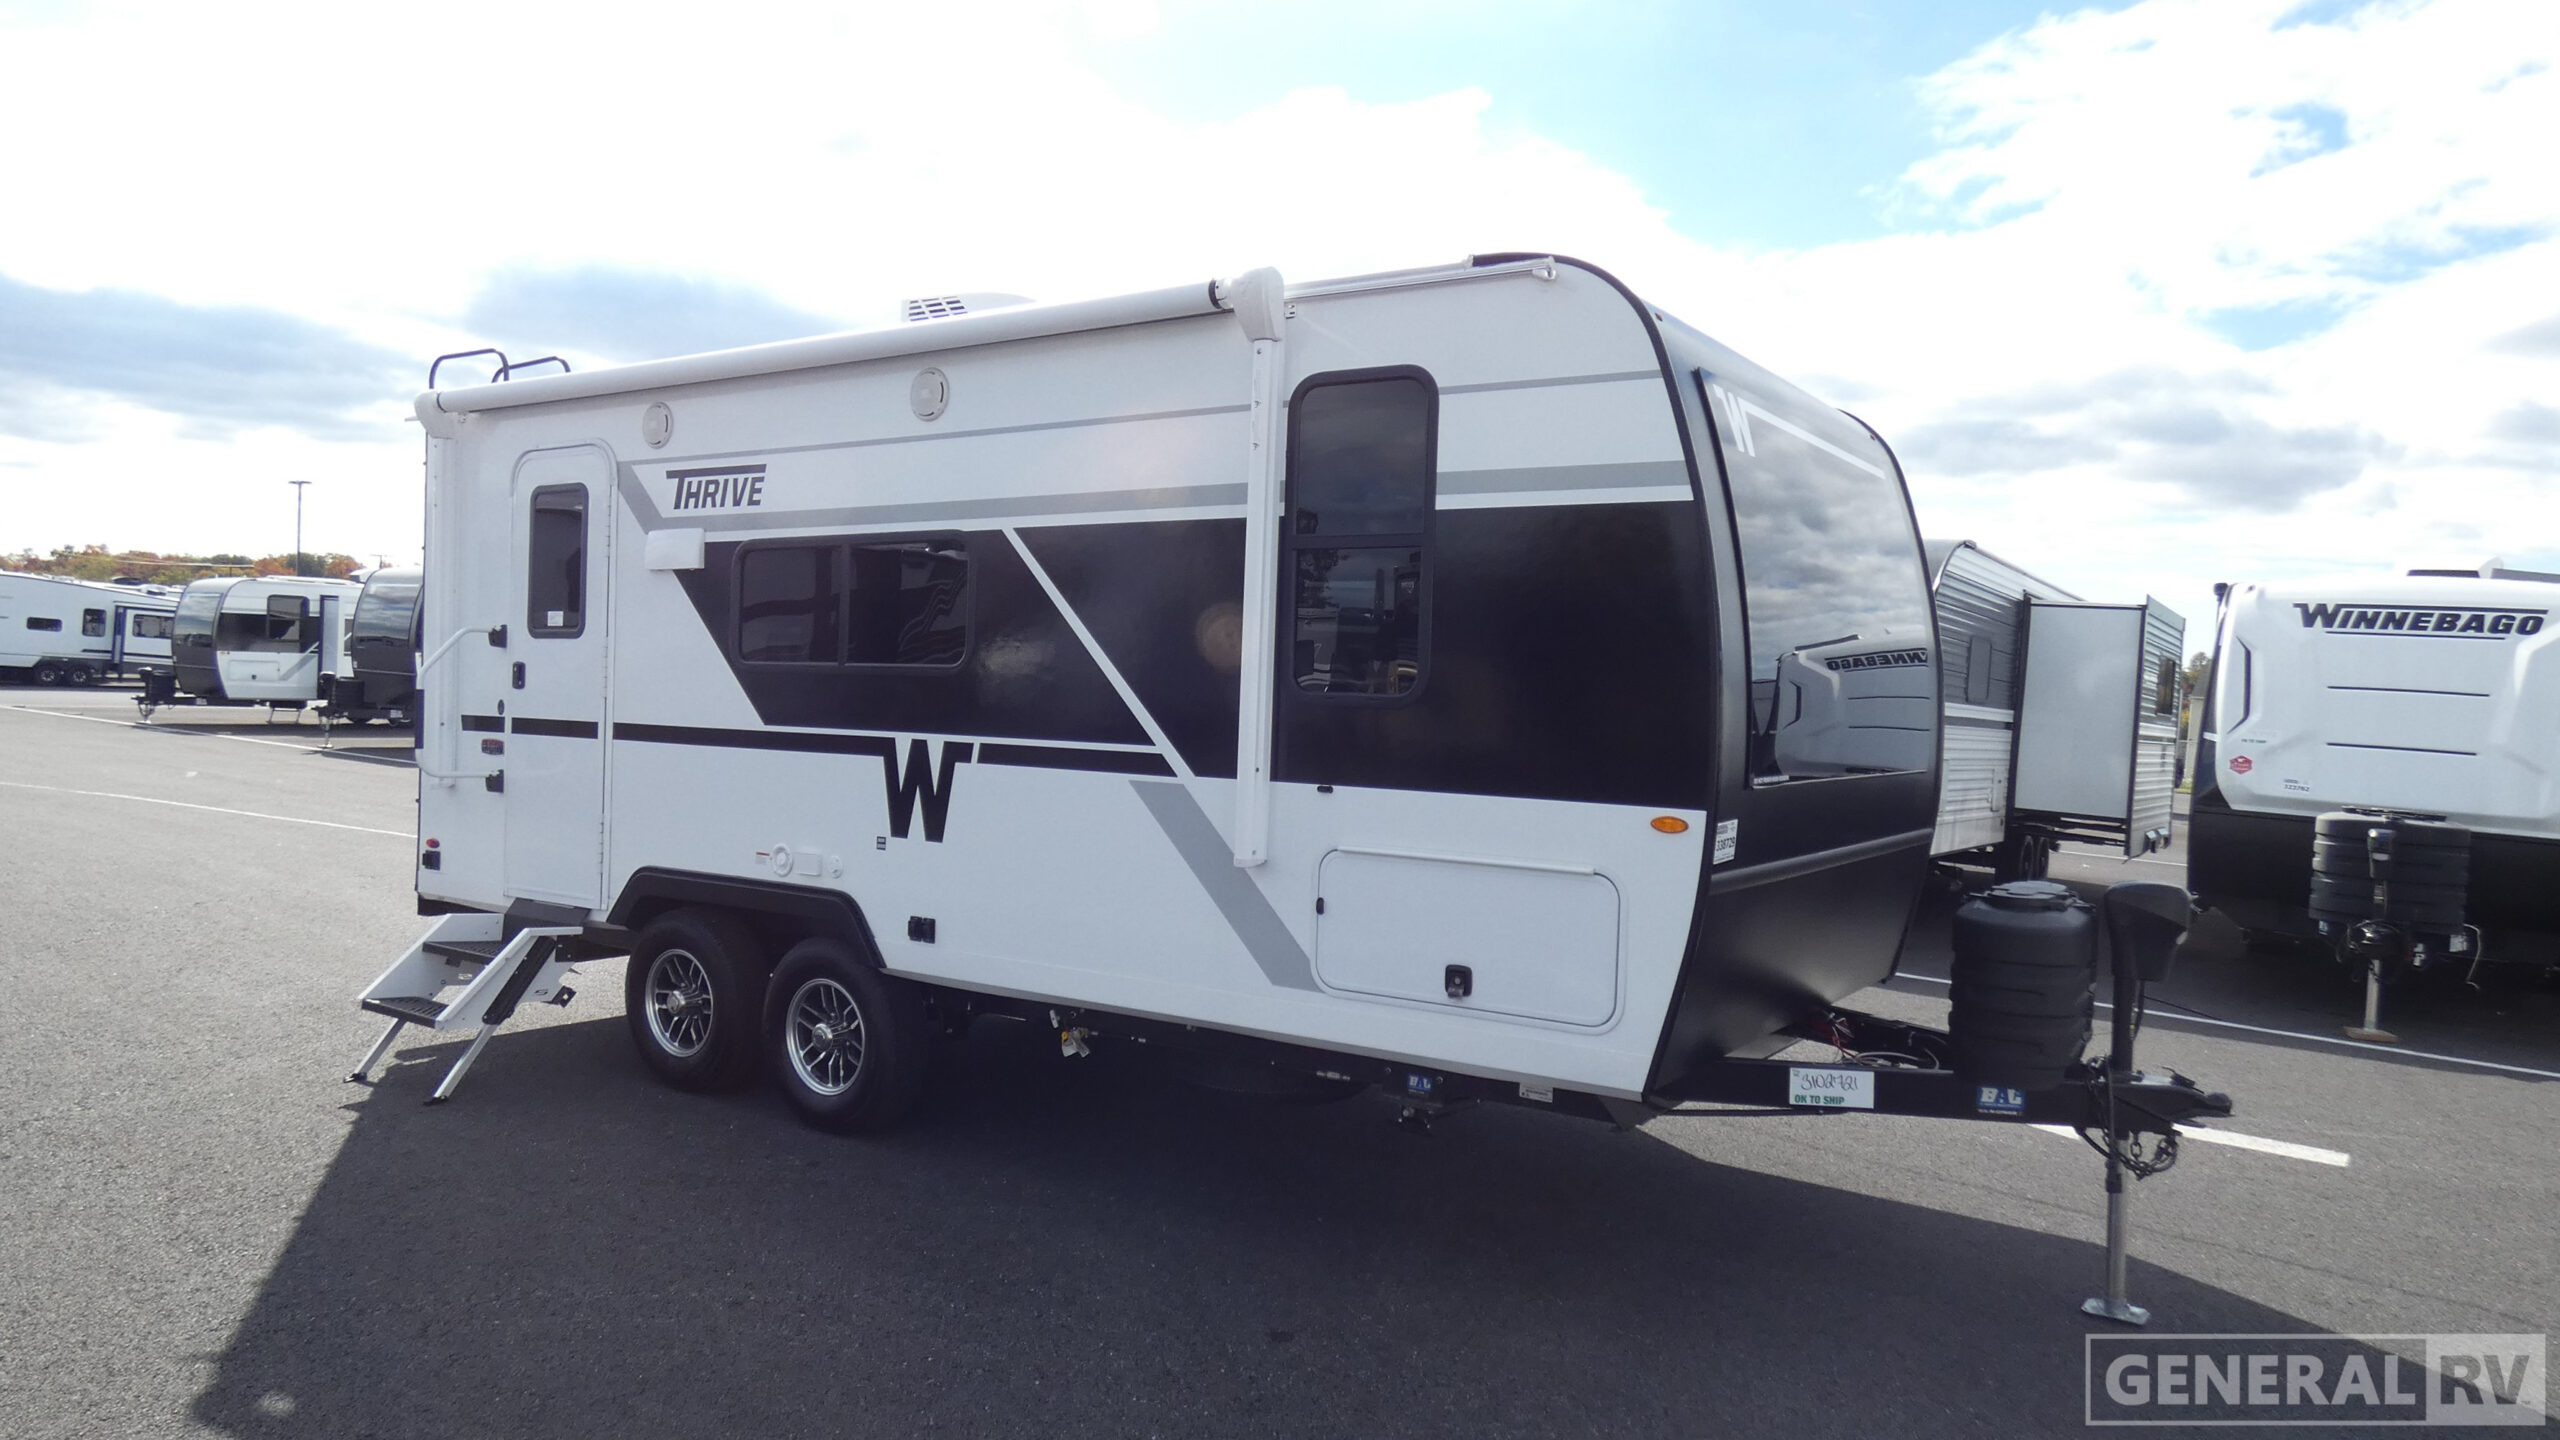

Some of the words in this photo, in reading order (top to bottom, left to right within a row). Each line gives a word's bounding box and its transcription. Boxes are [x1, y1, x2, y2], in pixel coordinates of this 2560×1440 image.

[666, 464, 767, 510] THRIVE
[2293, 603, 2549, 636] WINNEBAGO
[883, 737, 974, 843] W
[1794, 1094, 1807, 1104] OK
[1809, 1095, 1821, 1104] TO
[1823, 1095, 1845, 1105] SHIP
